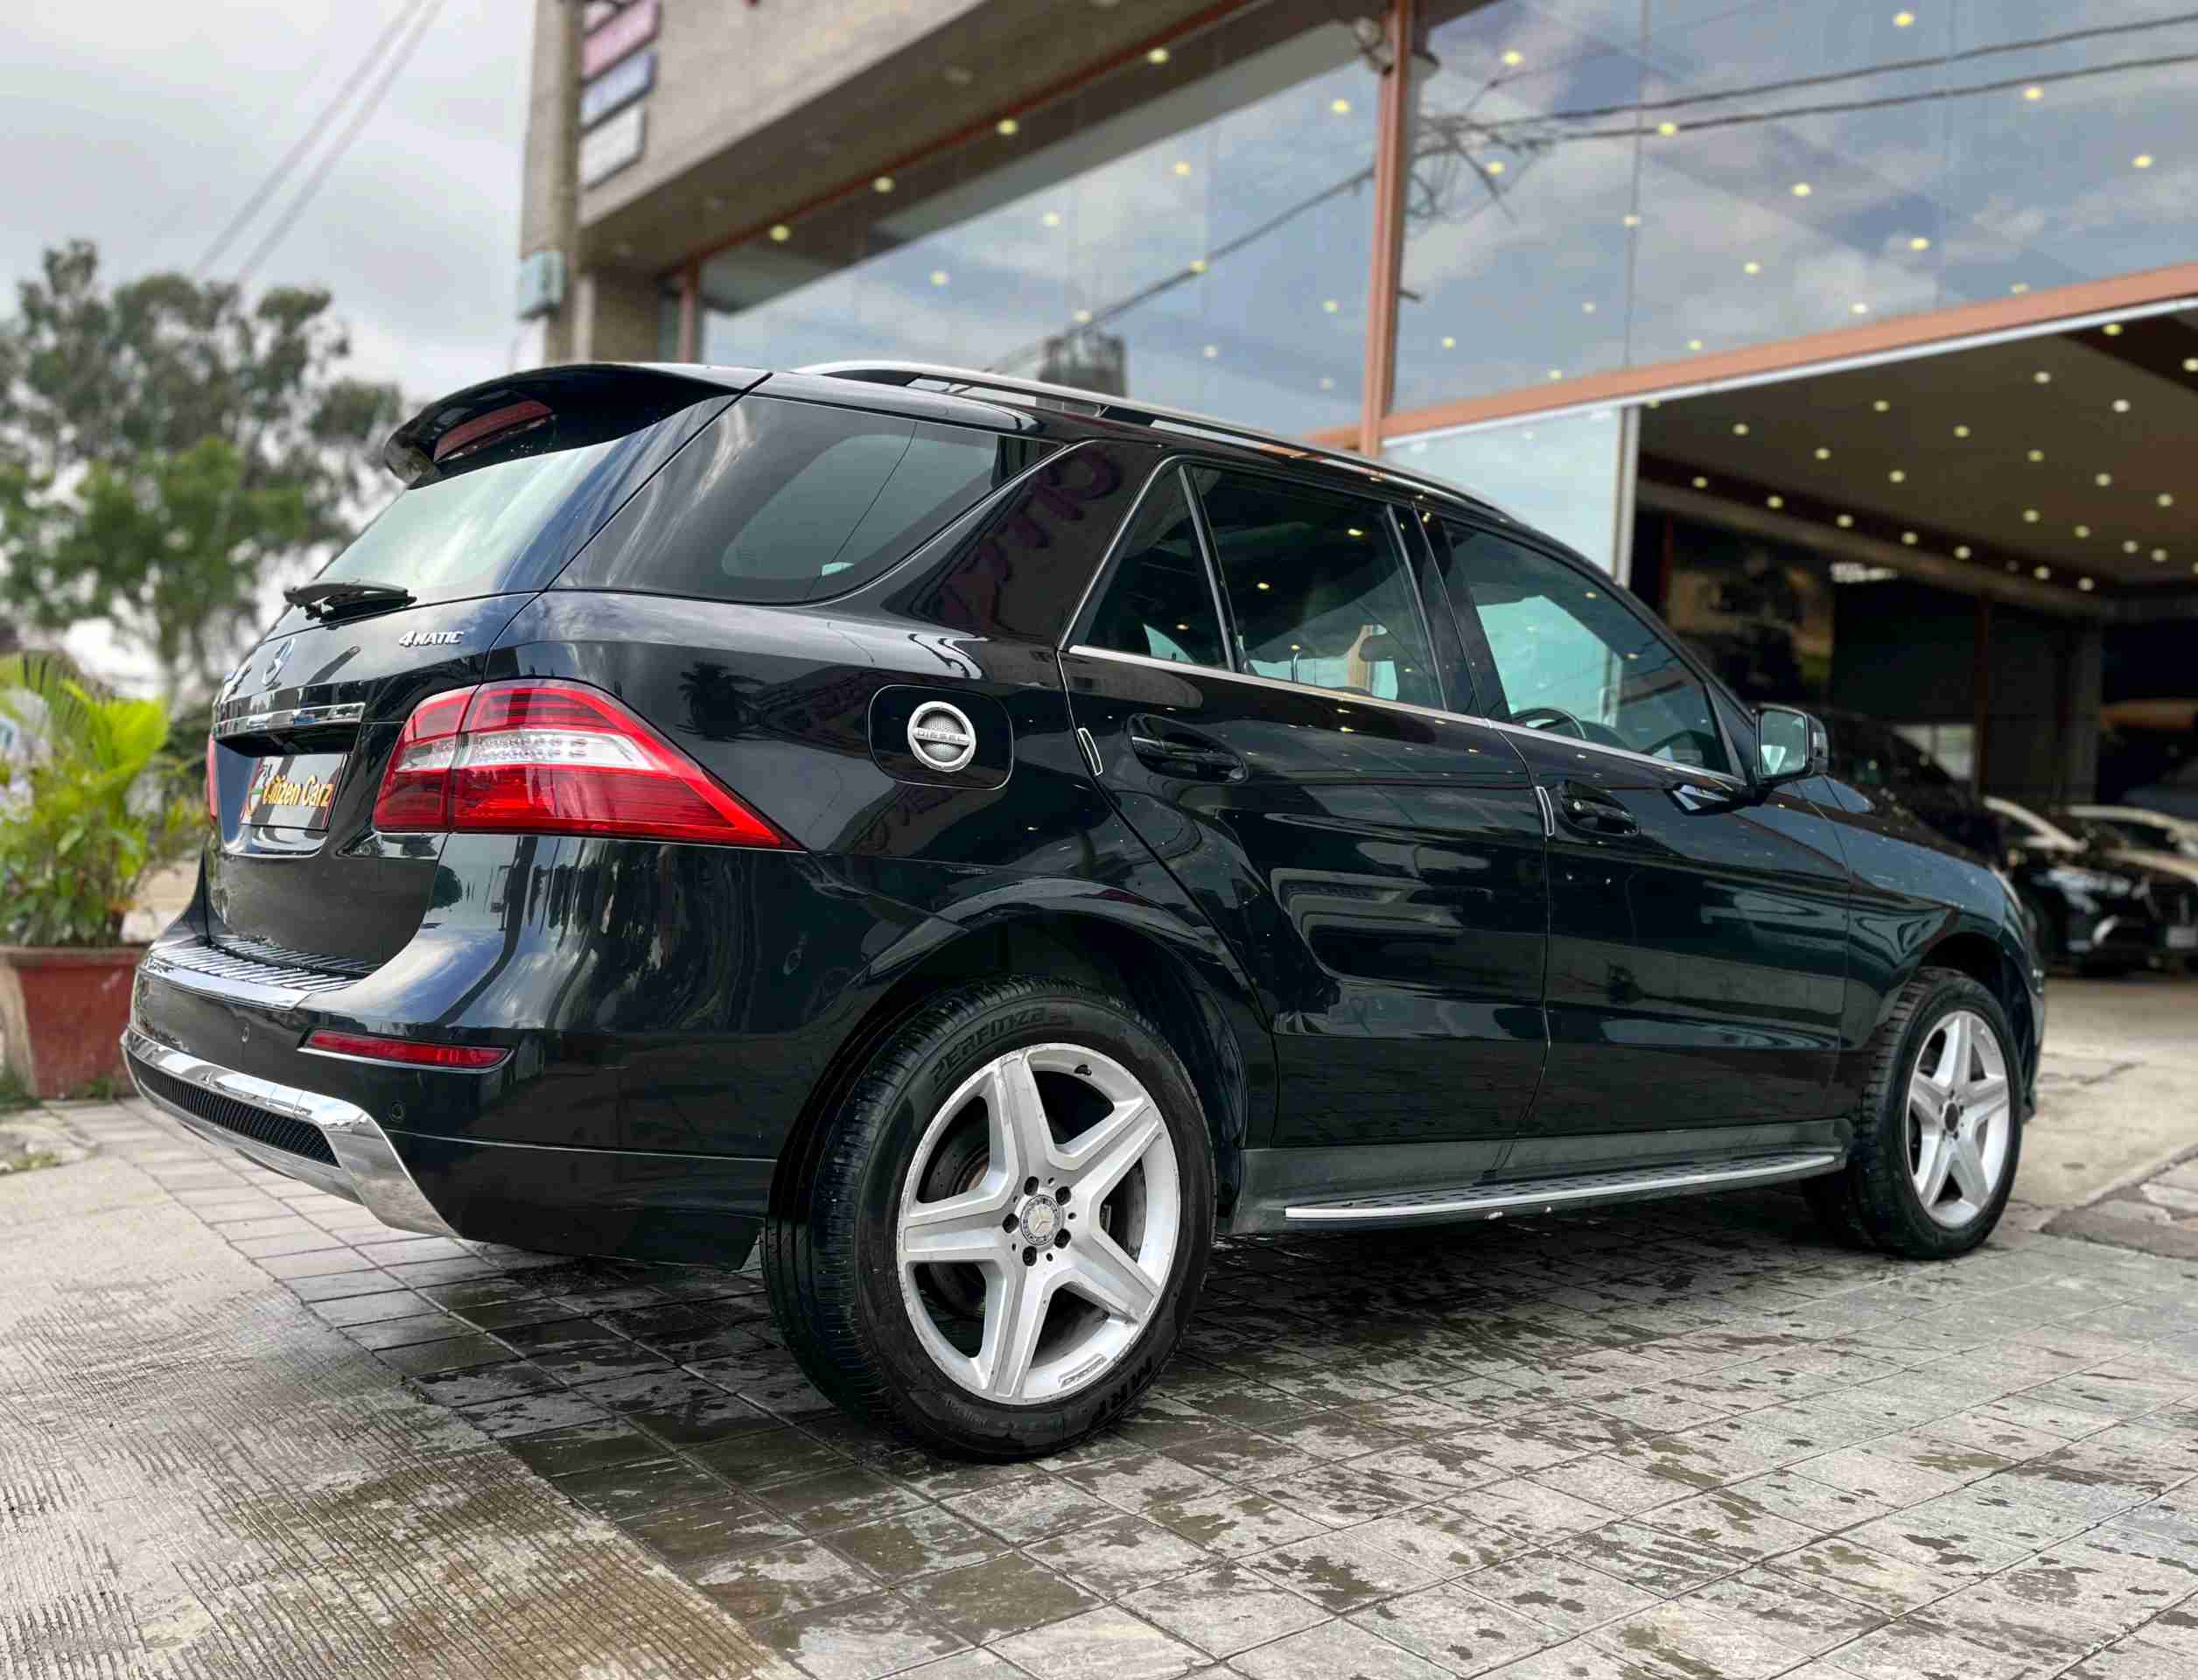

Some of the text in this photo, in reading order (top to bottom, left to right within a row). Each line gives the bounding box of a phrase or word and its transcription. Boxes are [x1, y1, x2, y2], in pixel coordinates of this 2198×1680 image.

[399, 630, 464, 647] 4MATIC
[917, 730, 967, 743] DIESEL
[301, 774, 335, 807] Carz
